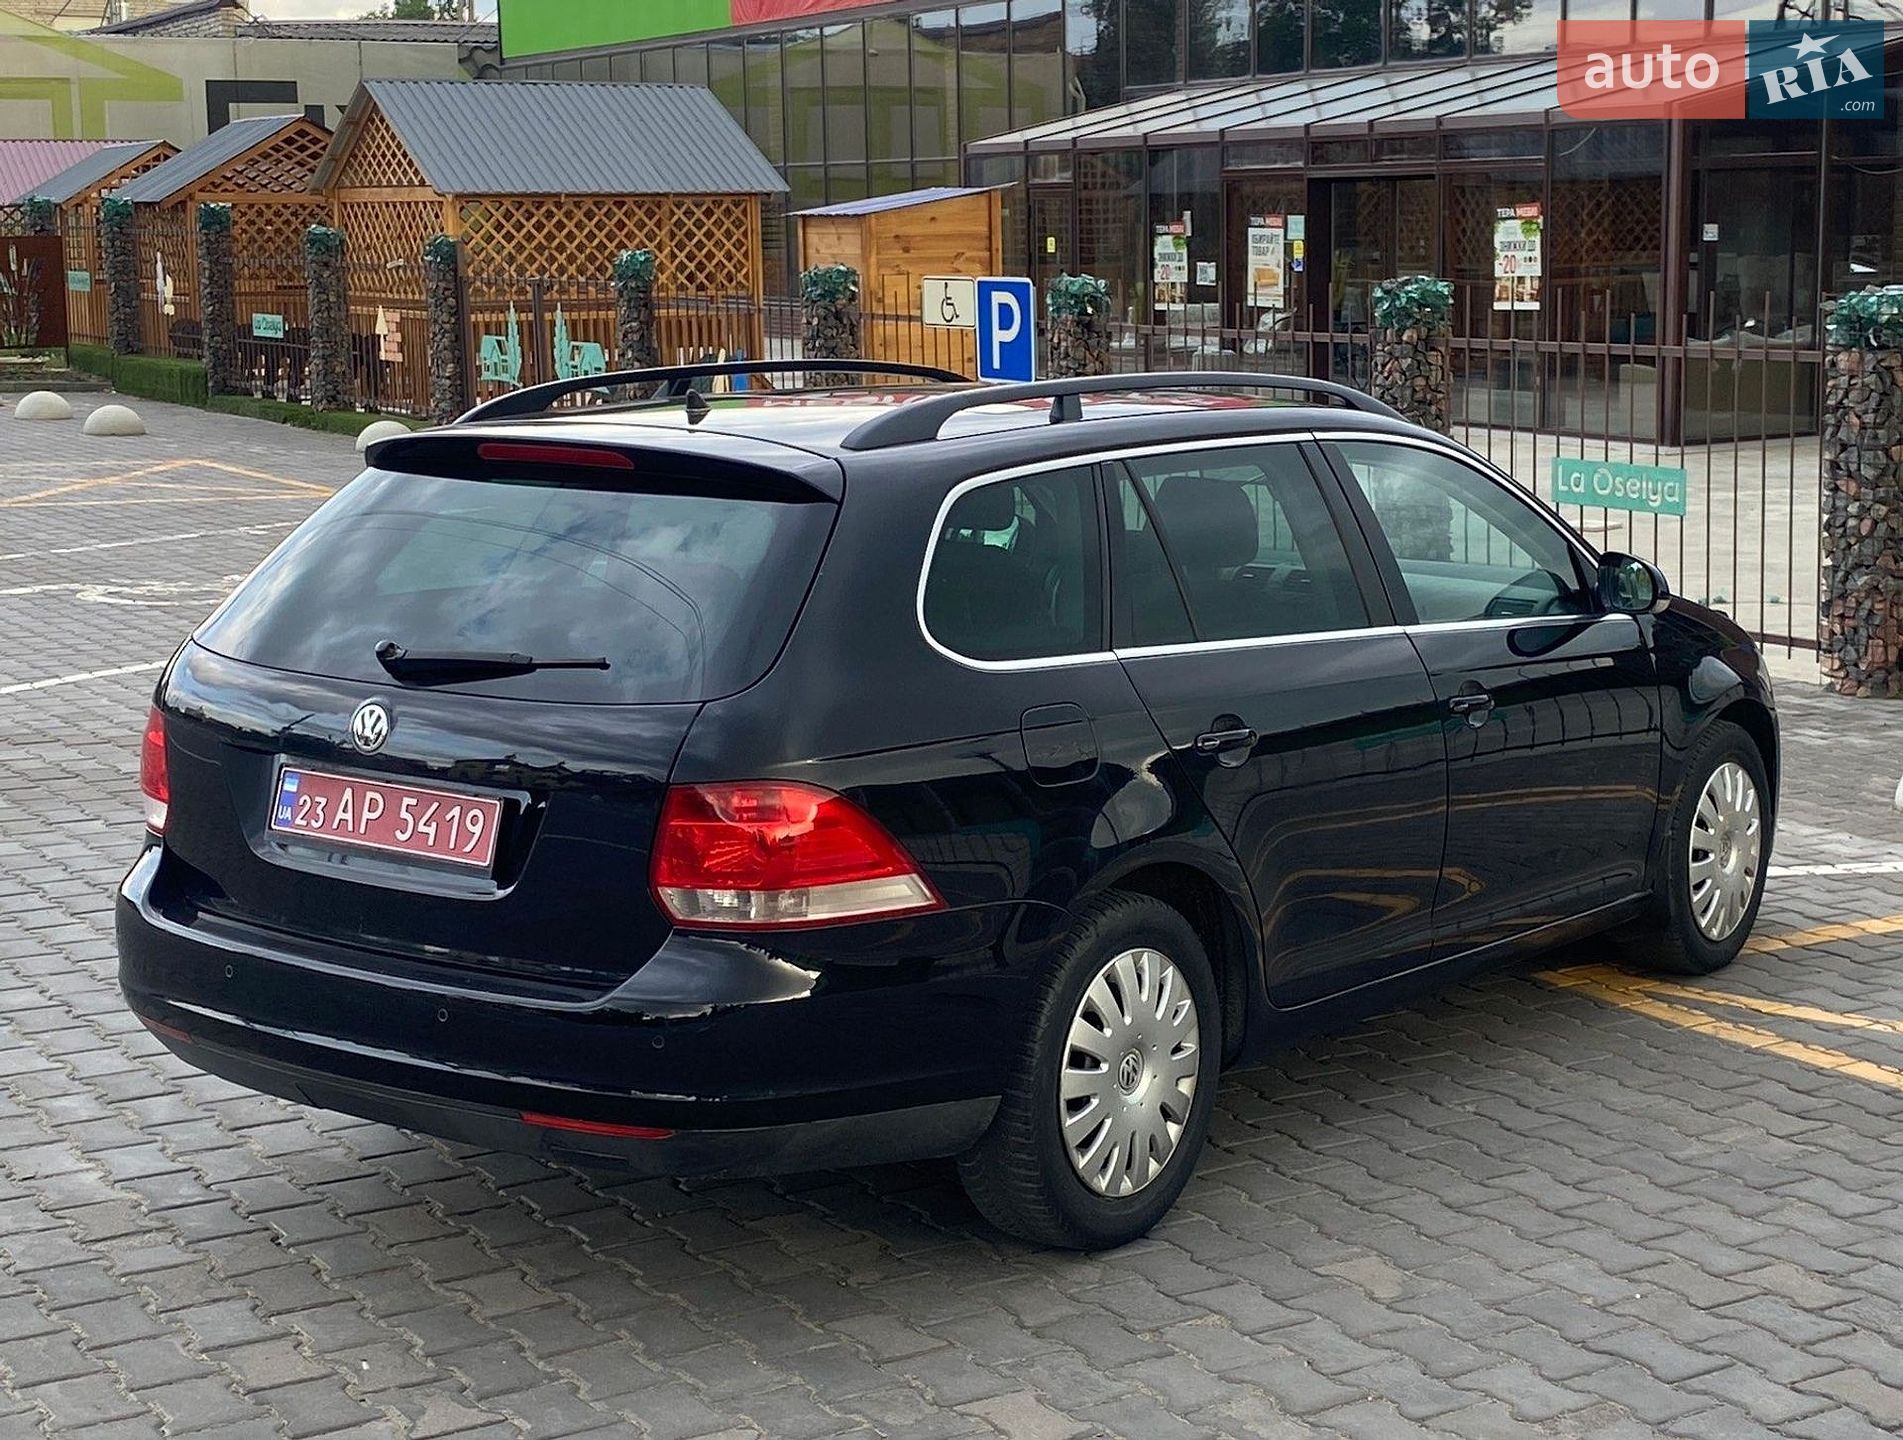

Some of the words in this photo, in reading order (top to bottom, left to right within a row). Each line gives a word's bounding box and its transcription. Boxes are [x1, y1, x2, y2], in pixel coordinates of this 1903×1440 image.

[991, 291, 1022, 370] P
[1557, 464, 1585, 494] La
[278, 804, 292, 821] UA
[294, 795, 328, 829] 23
[332, 787, 385, 835] AP
[394, 797, 486, 854] 5419
